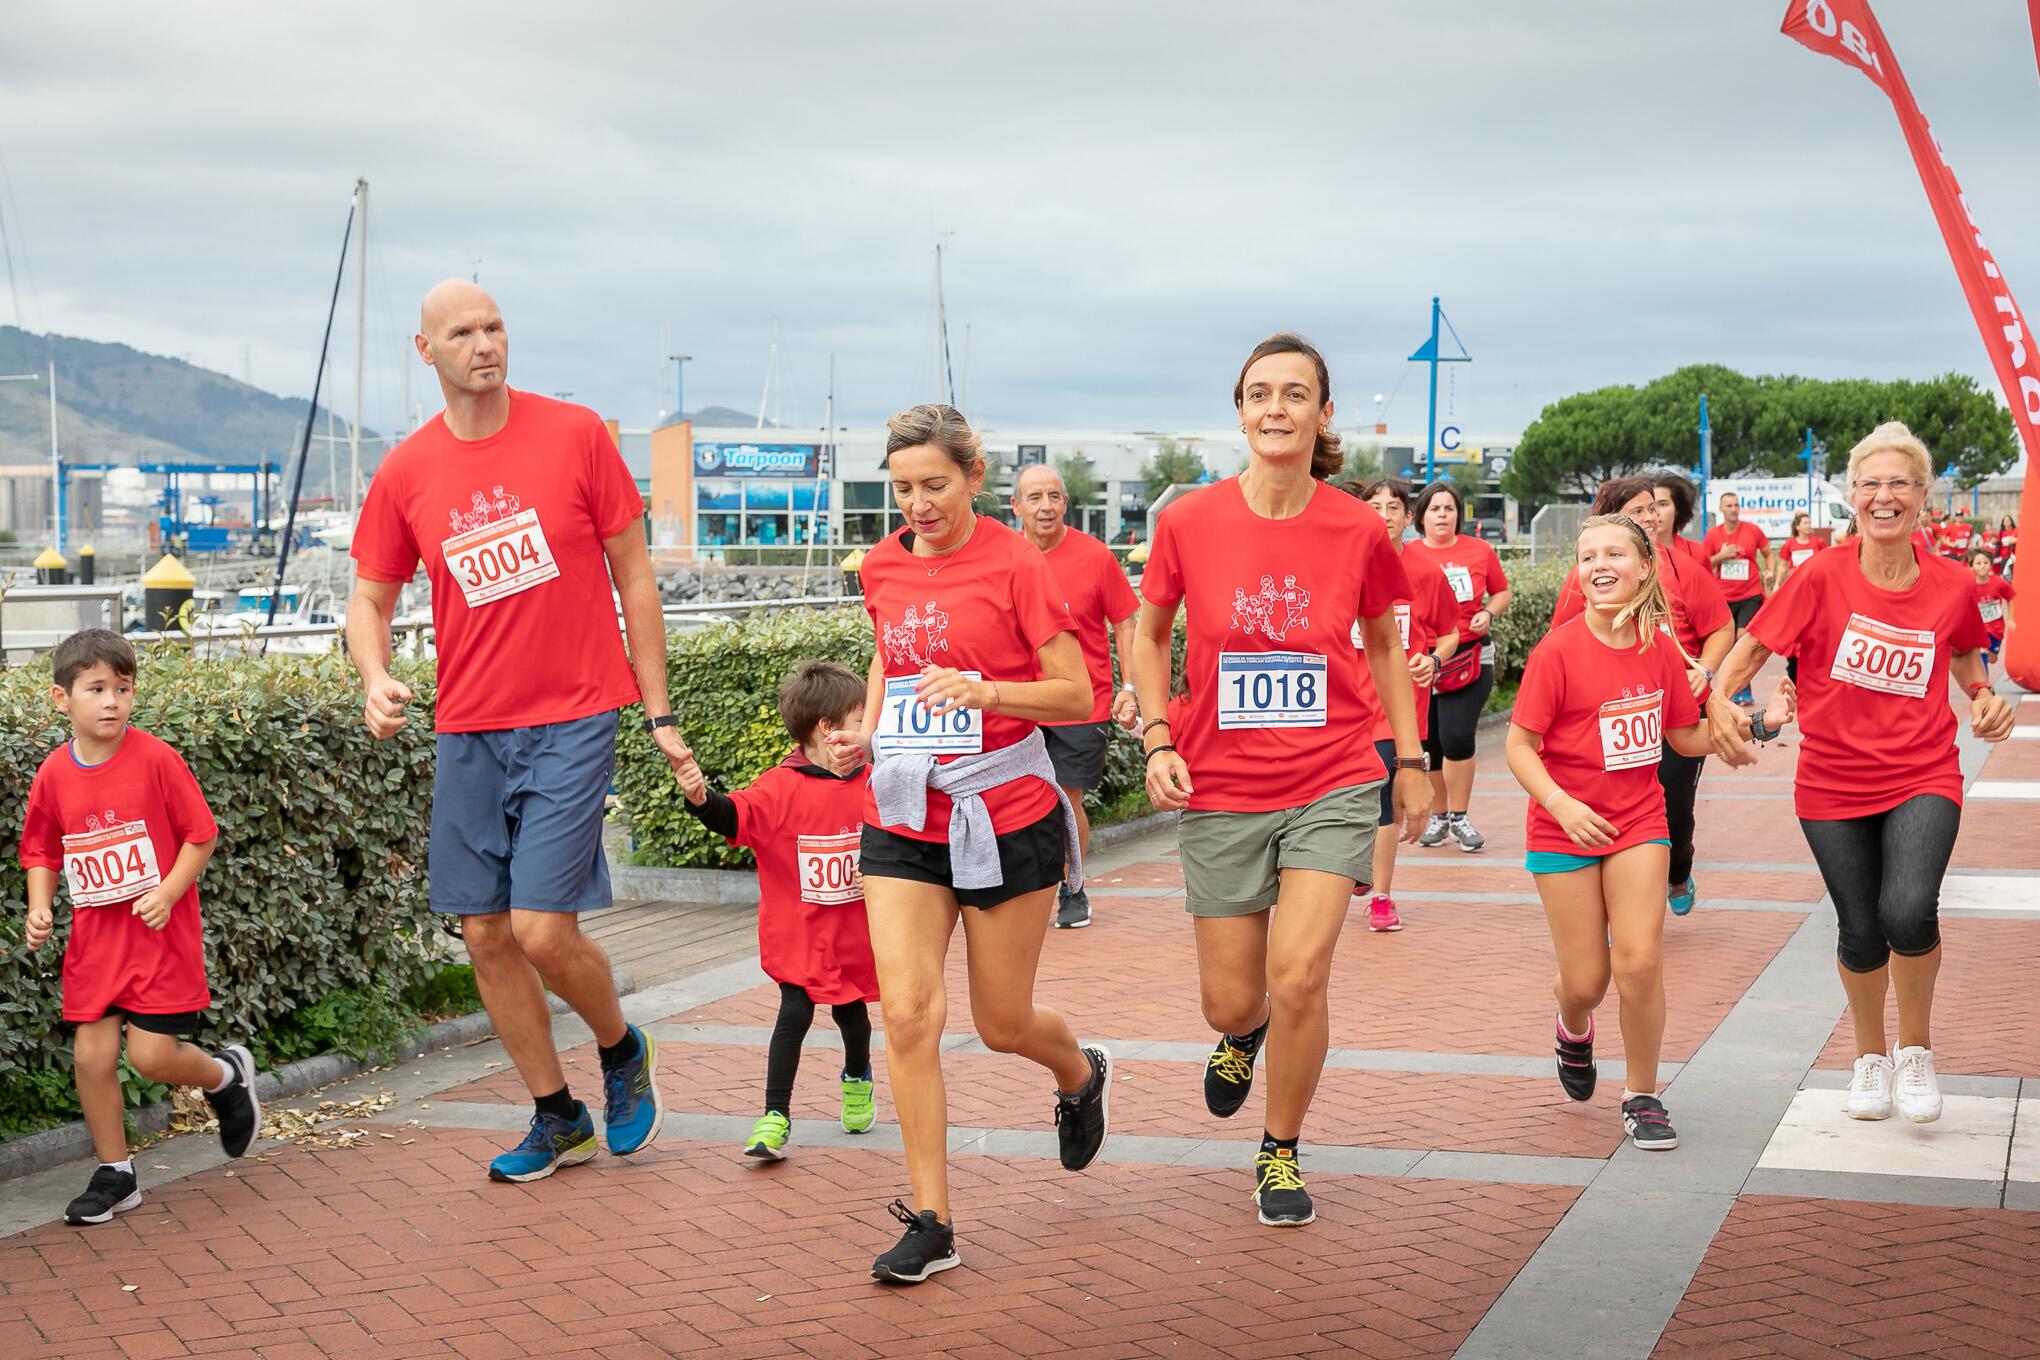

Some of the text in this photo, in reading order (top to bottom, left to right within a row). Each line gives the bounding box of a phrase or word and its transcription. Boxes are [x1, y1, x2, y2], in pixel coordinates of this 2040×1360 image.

[1441, 426, 1461, 450] C
[725, 448, 805, 470] Tarpoon
[459, 533, 540, 587] 3004
[1846, 638, 1924, 681] 3005
[1232, 672, 1317, 709] 1018
[893, 698, 971, 734] 1018
[1611, 712, 1661, 751] 300
[71, 844, 146, 891] 3004
